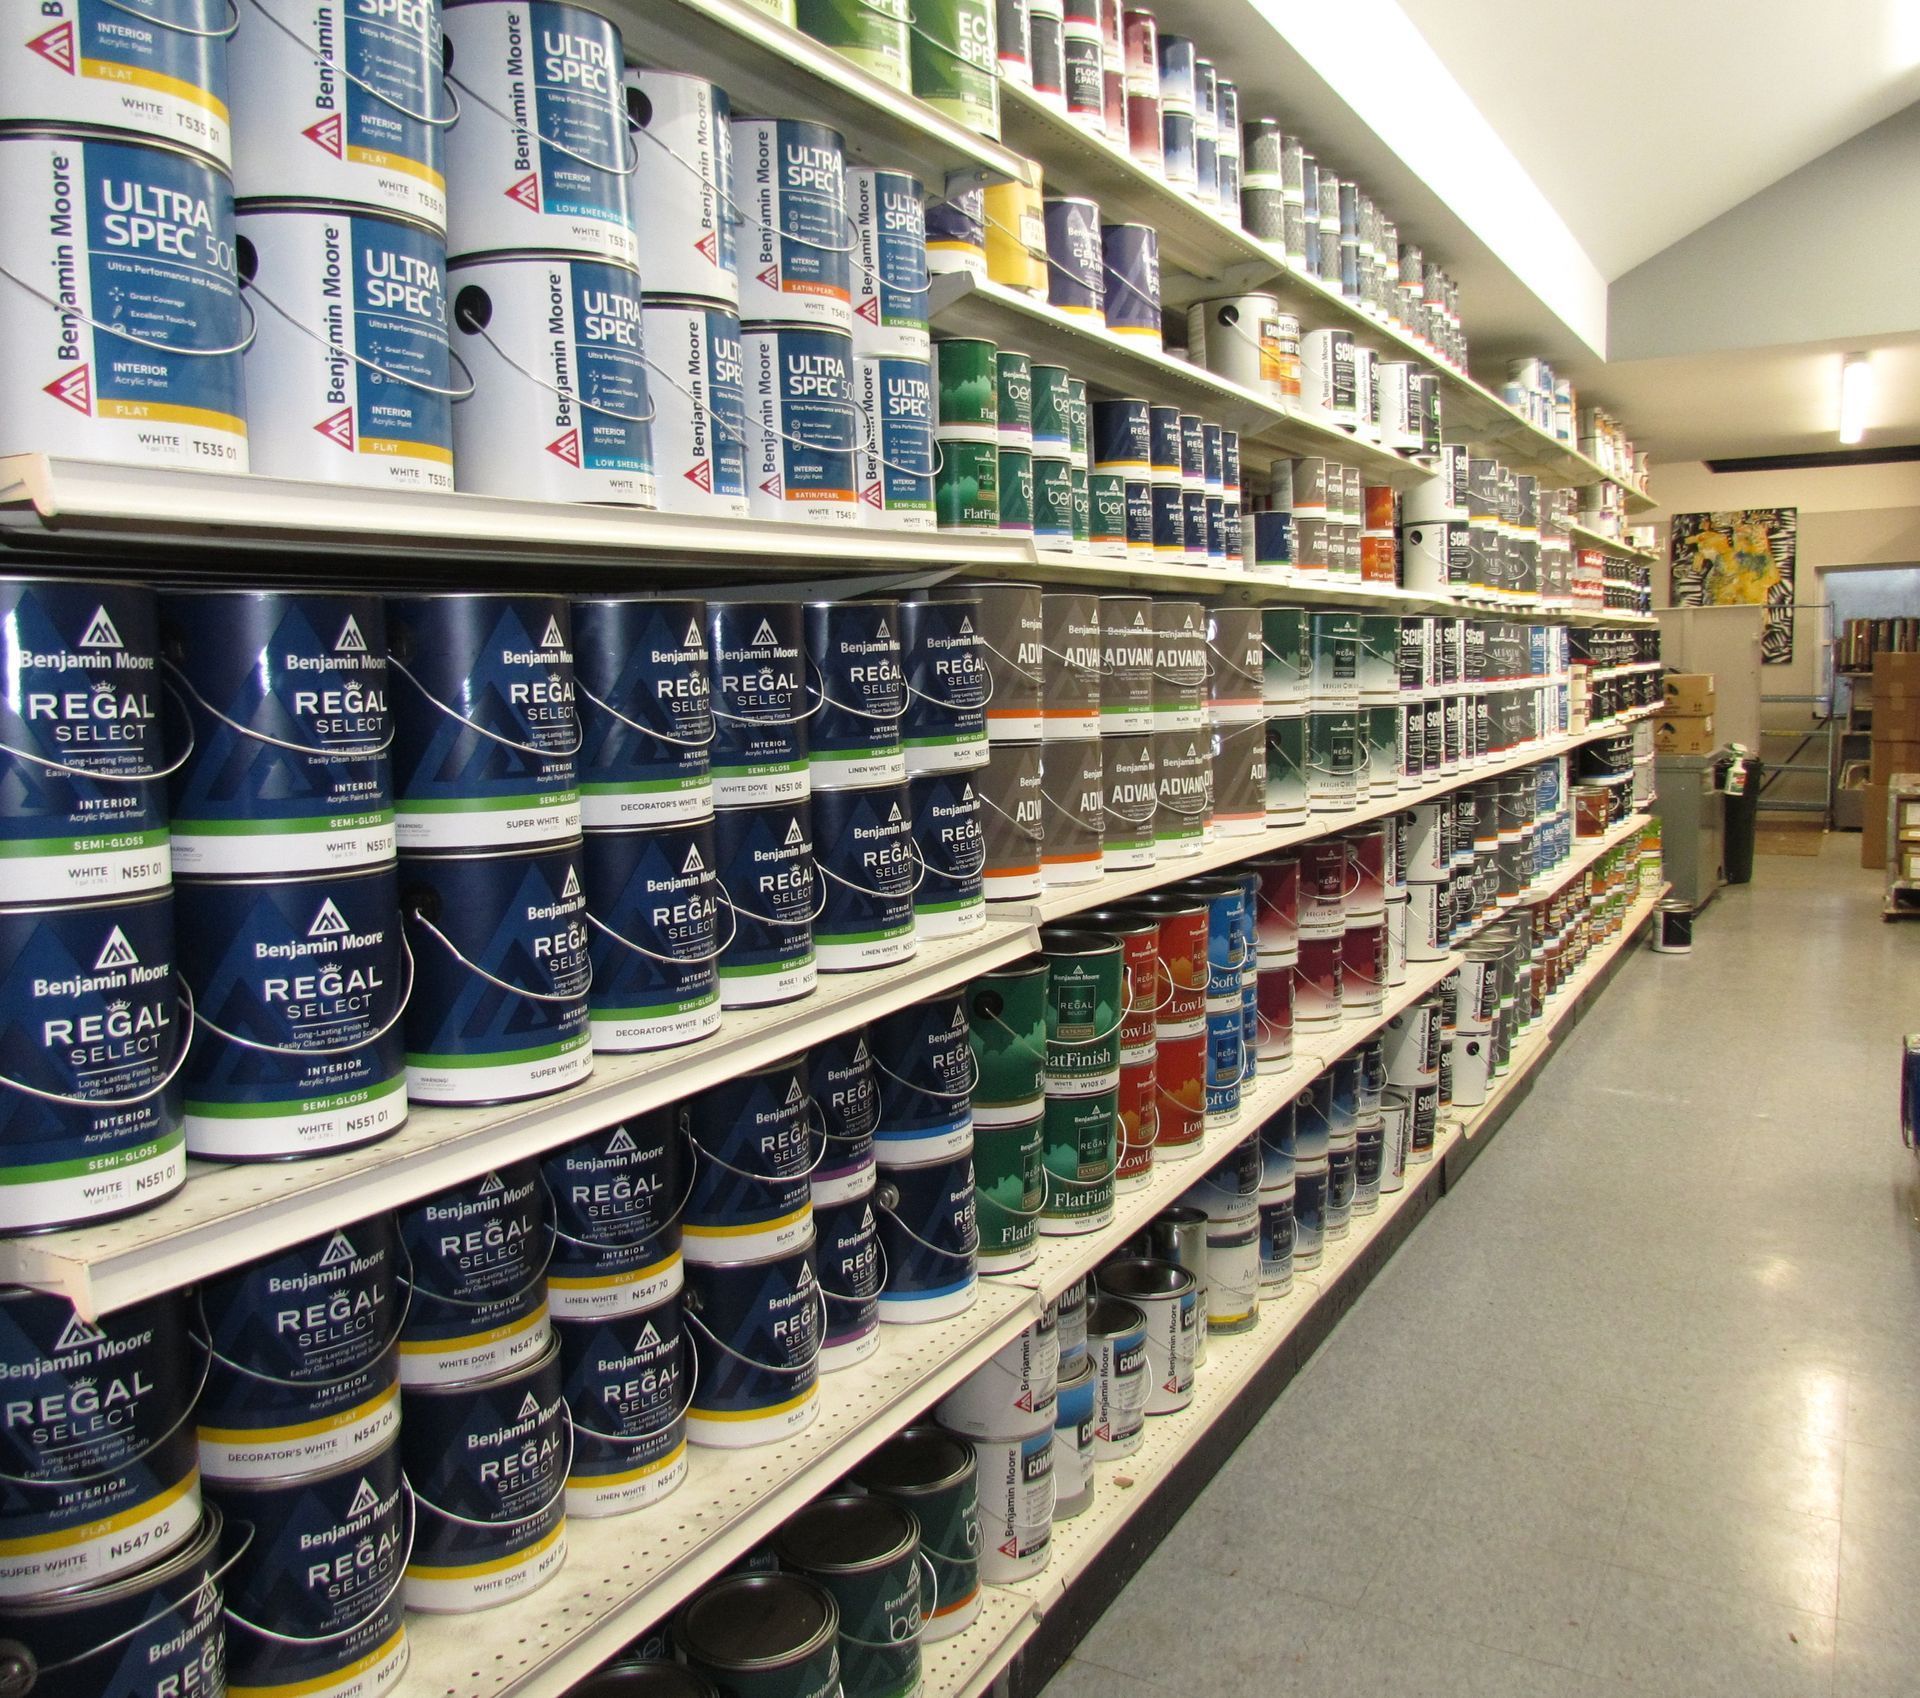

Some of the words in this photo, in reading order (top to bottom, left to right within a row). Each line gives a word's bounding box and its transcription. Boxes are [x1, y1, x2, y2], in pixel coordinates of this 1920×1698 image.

[100, 66, 134, 82] FLAT
[545, 58, 607, 94] SPEC
[121, 97, 164, 115] WHITE
[176, 113, 207, 136] T535
[210, 128, 220, 142] 01
[50, 155, 71, 237] Moore
[103, 179, 212, 232] ULTRA
[104, 214, 197, 259] SPEC
[107, 261, 132, 273] Ultra
[135, 264, 190, 285] Performance
[323, 227, 341, 298] Moore
[365, 249, 440, 293] ULTRA
[52, 245, 80, 361] Benjamin
[549, 274, 564, 334] Moore
[585, 316, 636, 347] SPEC
[324, 304, 349, 404] Benjamin
[788, 355, 845, 379] ULTRA
[113, 362, 168, 377] INTERIOR
[551, 340, 571, 427] Benjamin
[116, 405, 149, 417] FLAT
[138, 433, 180, 447] WHITE
[193, 440, 224, 458] T535
[227, 448, 237, 460] 01
[390, 467, 420, 478] WHITE
[20, 651, 111, 673] Benjamin
[116, 652, 153, 669] Moore
[503, 650, 558, 668] Benjamin
[1105, 648, 1153, 666] ADVAN
[722, 672, 798, 693] REGAL
[29, 693, 155, 720] REGAL
[737, 692, 792, 706] SELECT
[55, 724, 146, 742] SELECT
[316, 717, 383, 734] SELECT
[848, 766, 868, 774] LINEN
[868, 764, 887, 773] WHITE
[1116, 763, 1147, 773] Benjamin
[720, 785, 746, 793] WHITE
[747, 783, 768, 792] DOVE
[774, 782, 793, 793] N551
[79, 797, 137, 810] INTERIOR
[621, 799, 677, 812] DECORATOR'S
[678, 797, 698, 808] WHITE
[506, 819, 535, 830] SUPER
[537, 816, 560, 827] WHITE
[68, 866, 108, 878] WHITE
[122, 864, 150, 880] N551
[153, 862, 162, 875] 01
[256, 937, 338, 960] Benjamin
[342, 932, 383, 951] Moore
[861, 948, 881, 957] LINEN
[882, 945, 899, 954] WHITE
[34, 972, 126, 998] Benjamin
[131, 963, 169, 985] Moore
[264, 966, 383, 1003] REGAL
[779, 978, 794, 987] BASE
[287, 993, 373, 1020] SELECT
[1060, 1001, 1093, 1009] REGAL
[44, 1004, 170, 1047] REGAL
[615, 1022, 674, 1038] DECORATOR'S
[675, 1019, 697, 1031] WHITE
[70, 1034, 161, 1066] SELECT
[307, 1058, 362, 1077] INTERIOR
[303, 1091, 369, 1112] SEMI-GLOSS
[94, 1108, 151, 1130] INTERIOR
[298, 1121, 334, 1136] WHITE
[346, 1114, 375, 1133] N551
[378, 1109, 388, 1123] 01
[83, 1181, 123, 1199] WHITE
[136, 1168, 165, 1192] N551
[167, 1162, 176, 1180] 01
[588, 1194, 654, 1218] SELECT
[776, 1230, 795, 1242] BLACK
[459, 1238, 525, 1270] SELECT
[269, 1267, 346, 1294] Benjamin
[350, 1250, 385, 1275] Moore
[565, 1296, 590, 1305] LINEN
[591, 1293, 618, 1304] WHITE
[632, 1285, 657, 1300] N547
[277, 1285, 385, 1333] REGAL
[299, 1310, 376, 1347] SELECT
[0, 1350, 92, 1381] Benjamin
[98, 1331, 153, 1360] Moore
[439, 1357, 470, 1370] WHITE
[471, 1351, 496, 1365] DOVE
[6, 1370, 154, 1428] REGAL
[33, 1401, 139, 1445] SELECT
[228, 1446, 302, 1462] DECORATOR'S
[304, 1437, 338, 1455] WHITE
[354, 1421, 381, 1444] N547
[1007, 1449, 1017, 1487] Moore
[58, 1477, 127, 1505] INTERIOR
[596, 1491, 620, 1502] LINEN
[621, 1485, 646, 1499] WHITE
[1006, 1491, 1016, 1537] Benjamin
[0, 1565, 40, 1580] SUPER
[44, 1553, 88, 1571] WHITE
[111, 1530, 150, 1560] N547
[153, 1521, 171, 1540] 02
[474, 1579, 503, 1593] WHITE
[504, 1571, 527, 1585] DOVE
